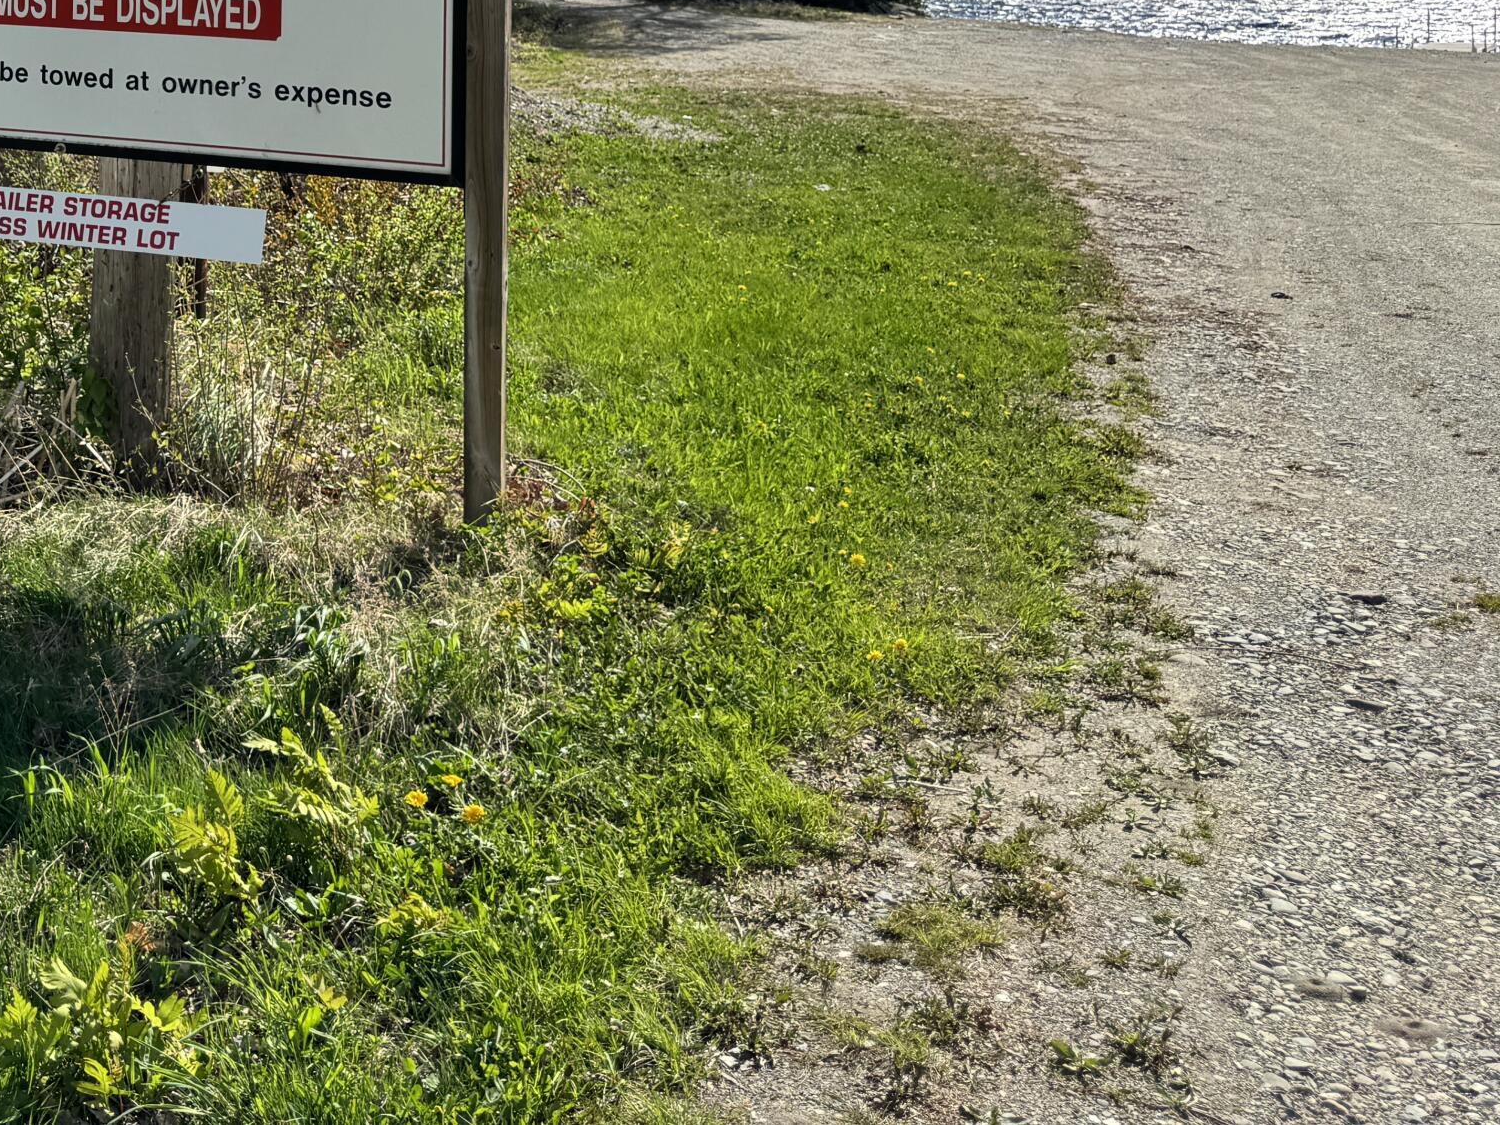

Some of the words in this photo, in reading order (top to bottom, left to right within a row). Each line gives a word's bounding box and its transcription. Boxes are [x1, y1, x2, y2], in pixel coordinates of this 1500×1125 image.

[0, 61, 28, 83] be
[40, 64, 113, 89] towed
[125, 71, 149, 91] at
[162, 75, 262, 99] owner's
[274, 83, 392, 109] expense
[63, 196, 170, 225] STORAGE
[37, 219, 127, 246] WINTER
[136, 228, 180, 250] LOT
